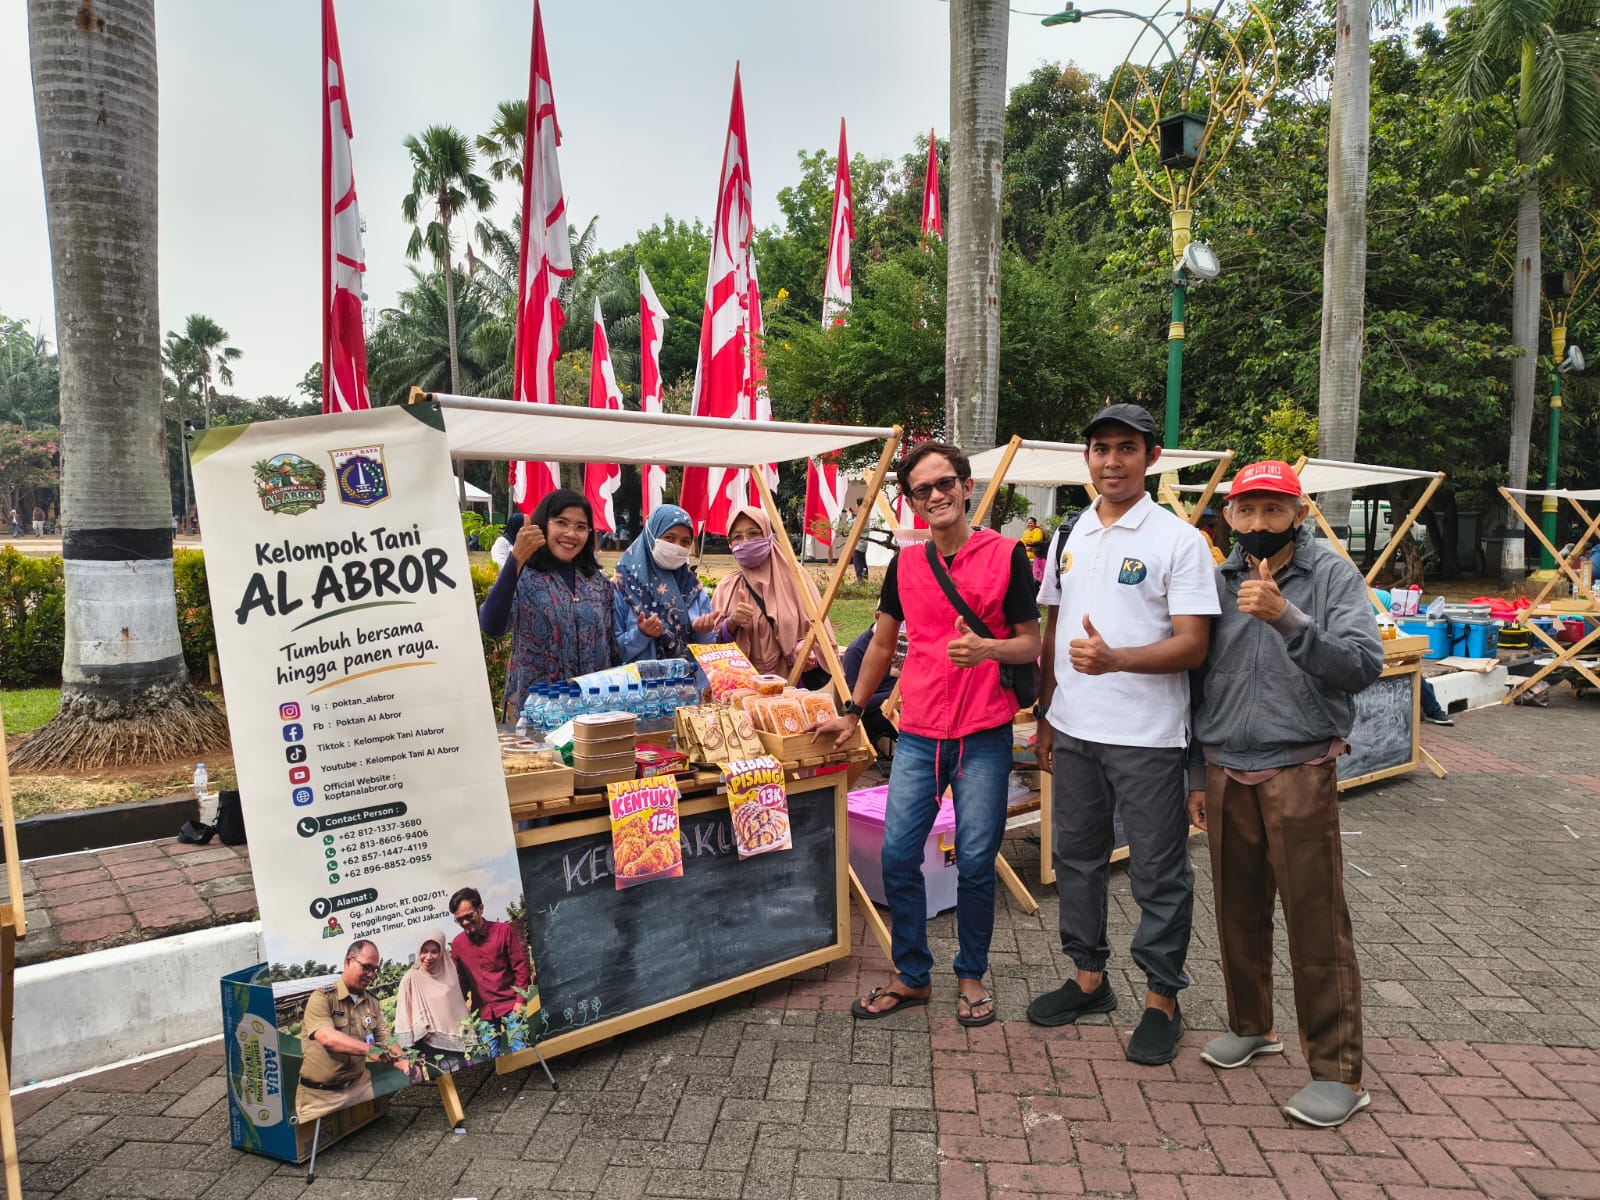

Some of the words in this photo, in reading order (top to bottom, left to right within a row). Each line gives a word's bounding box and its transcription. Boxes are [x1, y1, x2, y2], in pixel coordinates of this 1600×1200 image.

[264, 495, 281, 509] AL
[282, 490, 322, 504] ABROR
[256, 531, 368, 566] Kelompok
[370, 524, 420, 551] Tani
[235, 570, 303, 625] AL
[312, 548, 456, 609] ABROR
[280, 631, 351, 662] Tumbuh
[357, 622, 424, 645] bersama
[277, 660, 337, 685] hingga
[344, 649, 392, 675] panen
[398, 638, 439, 658] raya.
[311, 704, 320, 712] Ig
[332, 694, 395, 710] poktan_alabror
[313, 722, 324, 730] Fb
[336, 718, 366, 726] Poktan
[368, 714, 376, 722] Al
[379, 712, 402, 720] Abror
[317, 741, 345, 752] Tiktok
[354, 734, 395, 746] Kelompok
[396, 730, 414, 739] Tani
[415, 728, 445, 737] Alabror
[320, 760, 357, 772] Youtube
[366, 752, 407, 766] Kelompok
[408, 750, 425, 758] Tani
[426, 748, 435, 756] Al
[437, 746, 460, 755] Abror
[728, 757, 775, 775] KEBAB
[324, 780, 355, 792] Official
[356, 774, 391, 786] Website
[324, 782, 404, 800] koptanalabror.org
[618, 776, 669, 796] AYAM
[730, 766, 781, 793] PISANG
[611, 788, 677, 819] KENTUKY
[760, 790, 782, 804] 13K
[326, 812, 361, 826] Contact
[364, 808, 394, 819] Person
[652, 812, 676, 831] 15K
[340, 831, 355, 840] +62
[358, 818, 422, 836] 812-1337-3680
[341, 844, 357, 852] +62
[360, 830, 428, 849] 813-8606-9406
[342, 856, 359, 865] +62
[362, 842, 428, 862] 857-1447-4119
[344, 868, 361, 878] +62
[364, 854, 432, 874] 896-8852-0955
[336, 893, 368, 907] Alamat
[350, 911, 364, 920] Gg.
[374, 902, 399, 912] Abror,
[400, 898, 410, 906] RT.
[412, 890, 448, 903] 002/011,
[352, 911, 404, 930] Penggilingan,
[404, 904, 436, 916] Cakung,
[353, 928, 380, 940] Jakarta
[382, 921, 406, 932] Timur,
[407, 916, 420, 926] DKI
[422, 910, 450, 922] Jakarta
[264, 1046, 280, 1096] AQUA
[256, 1068, 264, 1102] UNTUNG
